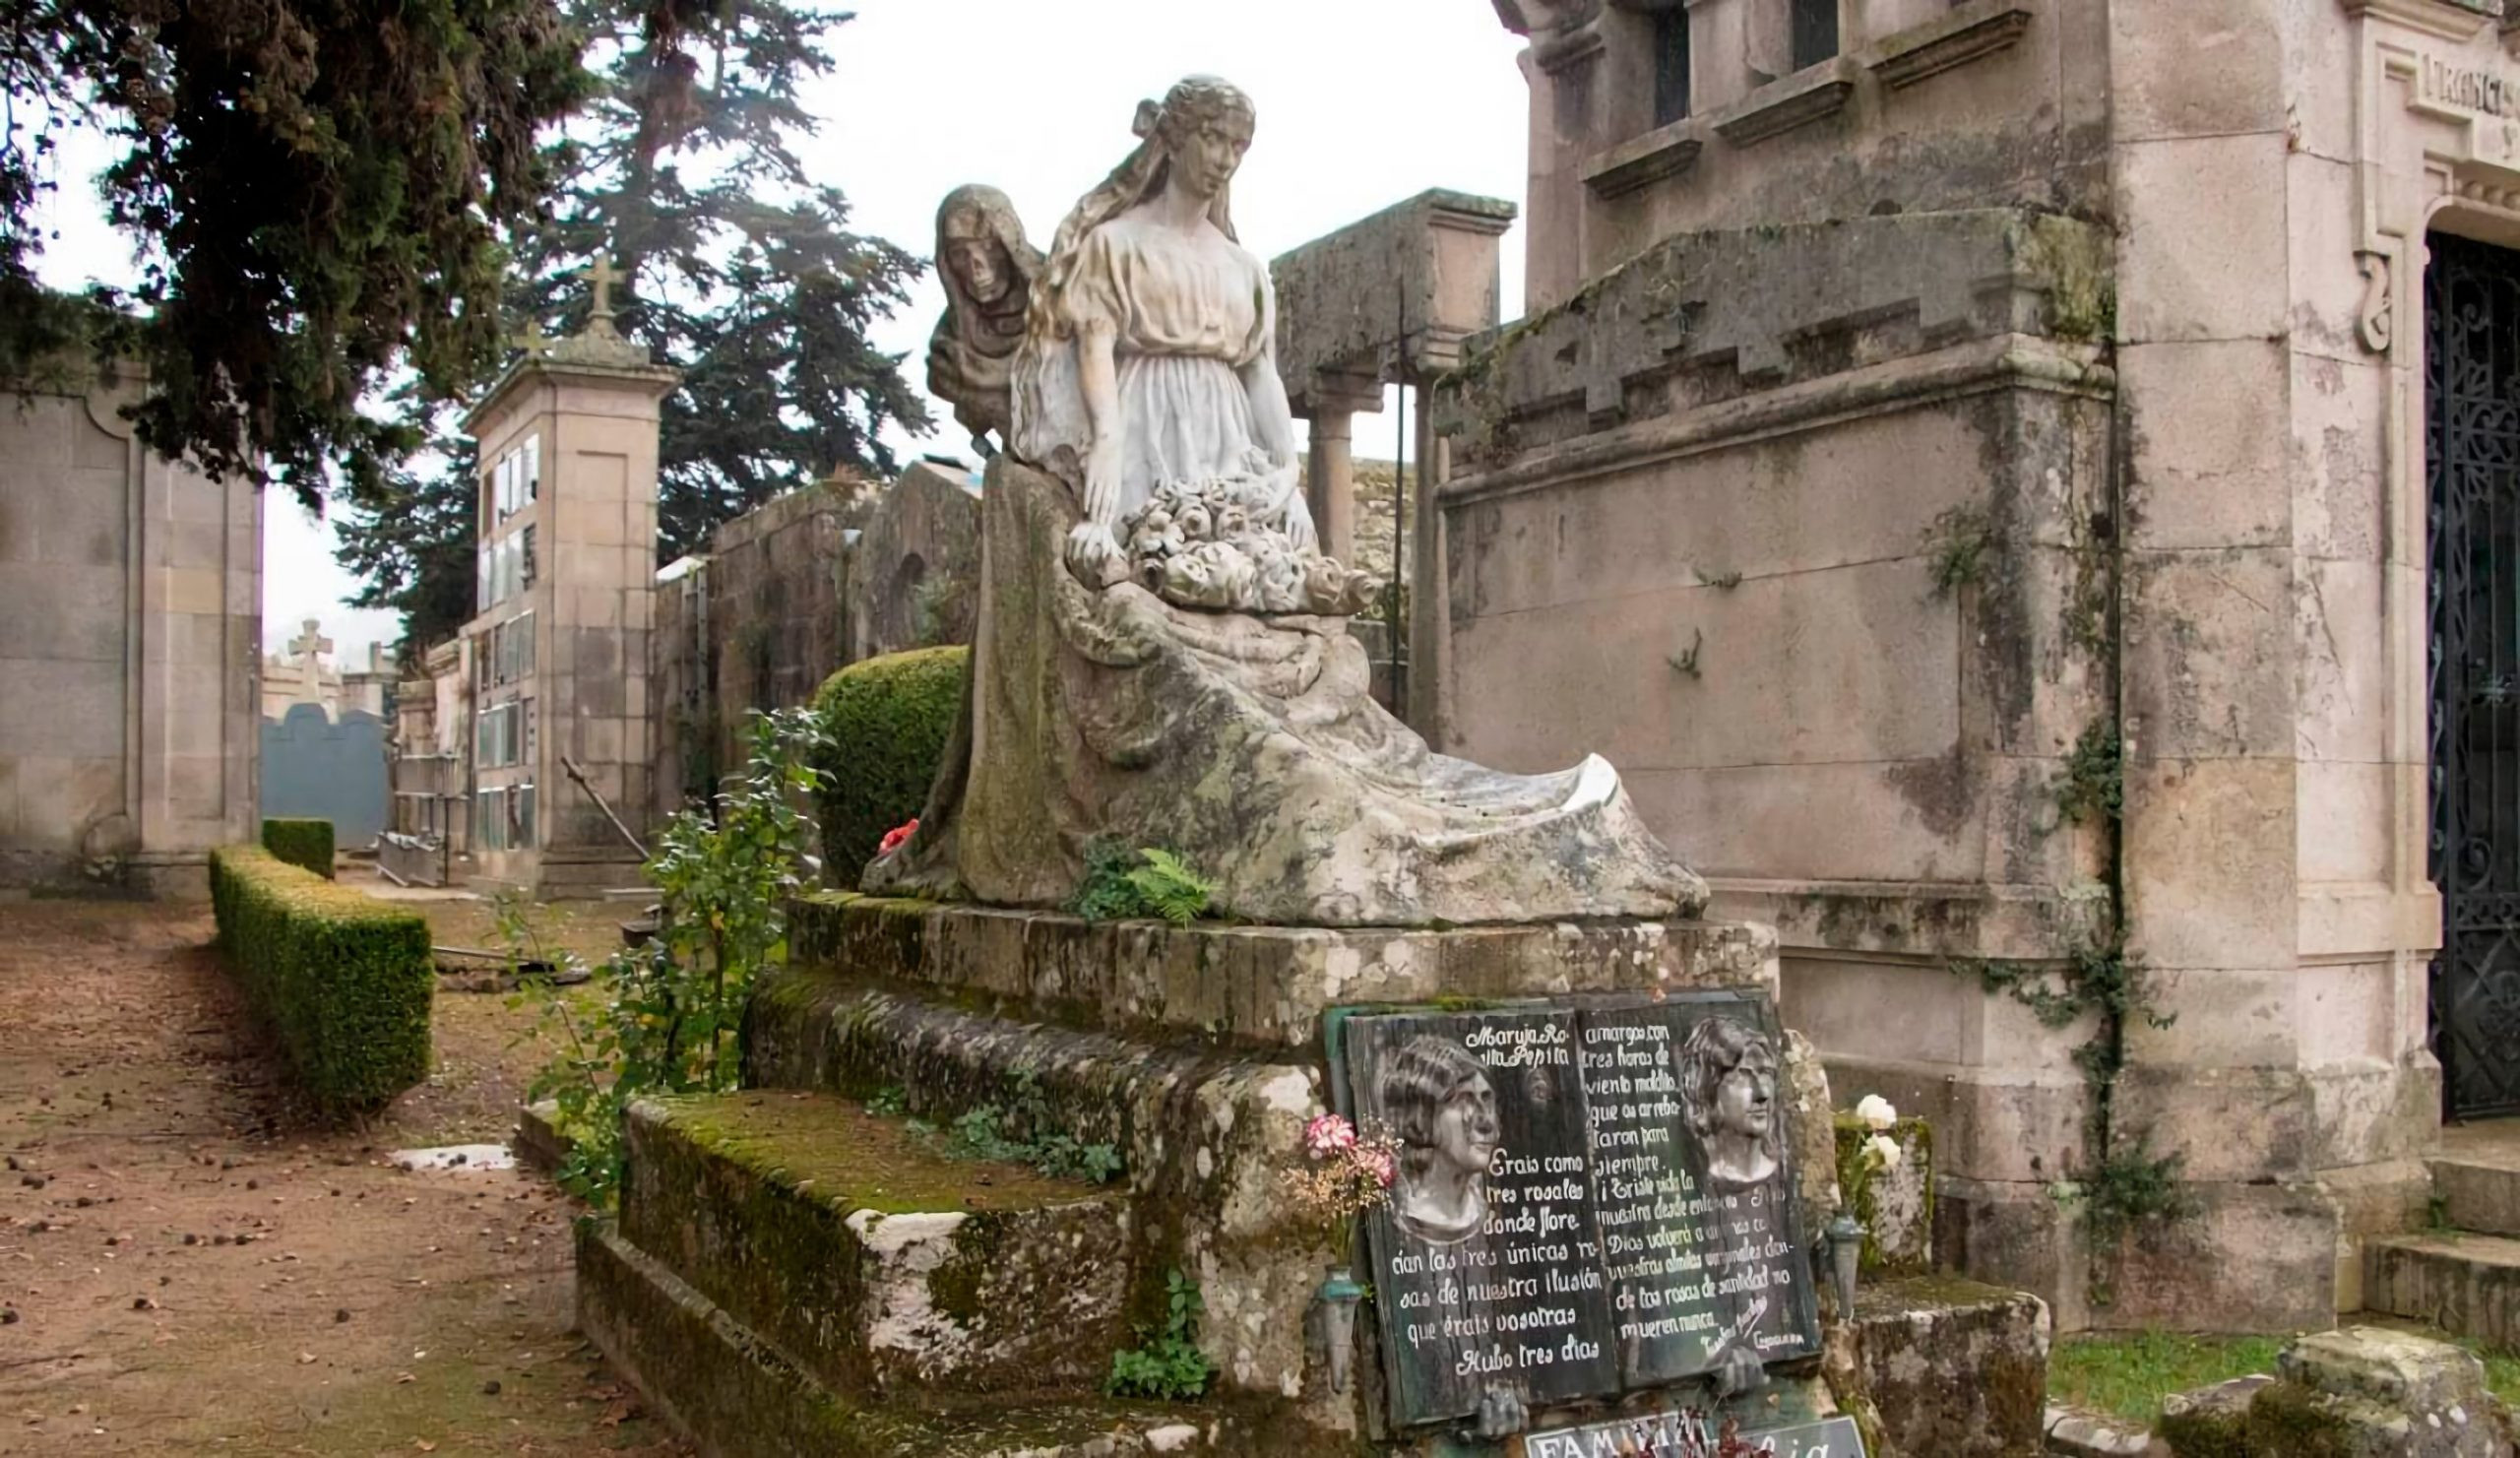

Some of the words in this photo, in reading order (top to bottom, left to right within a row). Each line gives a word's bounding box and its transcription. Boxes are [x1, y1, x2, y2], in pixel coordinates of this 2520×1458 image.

[1502, 1046, 1569, 1069] Pepita
[1582, 1050, 1613, 1069] tres
[1616, 1044, 1653, 1068] horas
[1655, 1042, 1670, 1065] de
[1586, 1074, 1631, 1095] viento
[1590, 1105, 1618, 1128] que
[1593, 1129, 1639, 1150] taron
[1641, 1126, 1670, 1150] para
[1488, 1147, 1540, 1177] Erais
[1544, 1155, 1584, 1173] como
[1485, 1184, 1517, 1204] tres
[1523, 1177, 1584, 1202] rosales
[1482, 1205, 1536, 1236] donde
[1654, 1194, 1687, 1221] desde
[1606, 1232, 1645, 1256] Dios
[1391, 1248, 1423, 1276] cían
[1427, 1246, 1457, 1273] las
[1506, 1241, 1569, 1266] únicas
[1399, 1290, 1431, 1309] sas
[1436, 1277, 1460, 1305] de
[1467, 1276, 1539, 1302] nuestra
[1615, 1284, 1636, 1311] de
[1664, 1280, 1701, 1306] rosas
[1701, 1272, 1717, 1300] de
[1407, 1322, 1437, 1350] que
[1619, 1318, 1678, 1341] mueren
[1455, 1341, 1514, 1377] Hubo
[1519, 1343, 1554, 1367] tres
